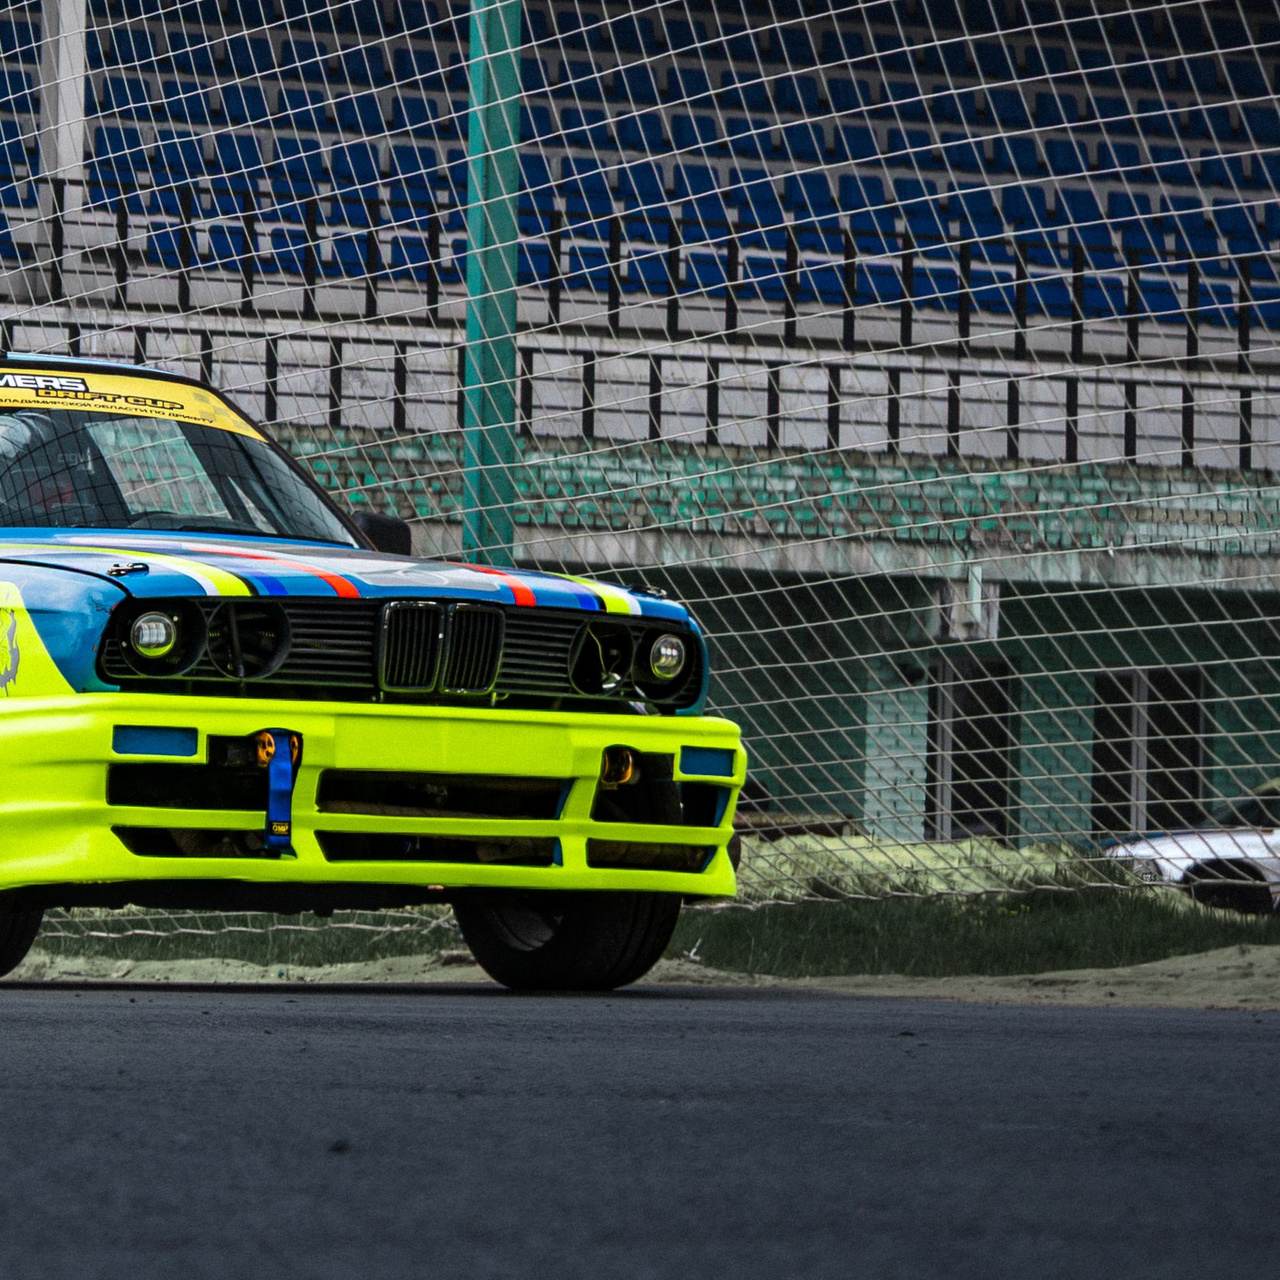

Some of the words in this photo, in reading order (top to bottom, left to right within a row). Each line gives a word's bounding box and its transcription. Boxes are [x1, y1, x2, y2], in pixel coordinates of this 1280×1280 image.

[36, 389, 121, 403] DRIFT
[124, 395, 184, 410] CUP
[93, 403, 147, 413] ОБЛАСТИ
